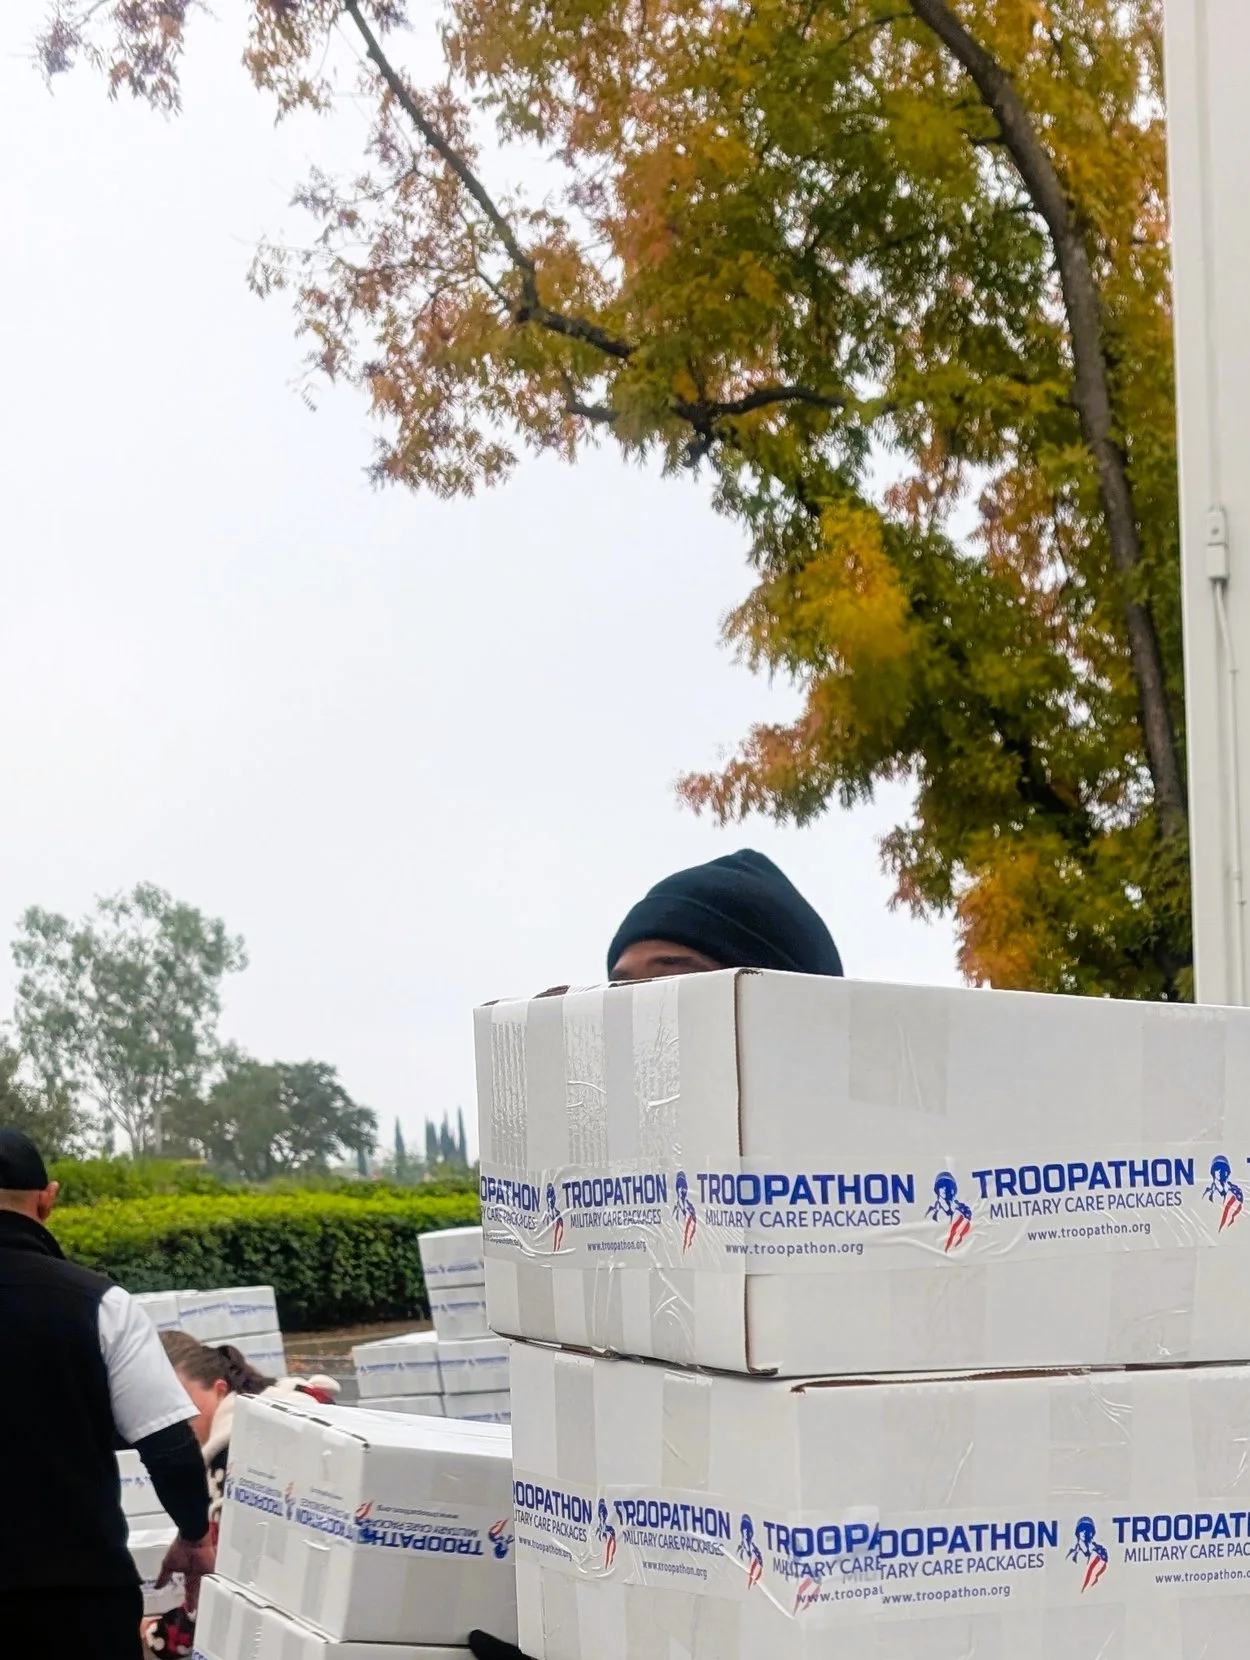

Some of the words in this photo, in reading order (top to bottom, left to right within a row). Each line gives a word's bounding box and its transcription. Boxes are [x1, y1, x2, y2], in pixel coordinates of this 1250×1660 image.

[696, 1173, 915, 1206] TROOPATHON
[972, 1158, 1194, 1199] TROOPATHON
[562, 1174, 668, 1209] TROOPATHON
[989, 1197, 1062, 1220] MILITARY
[1065, 1194, 1105, 1213] CARE
[1107, 1191, 1182, 1211] PACKAGES
[570, 1212, 601, 1229] MILITARY
[603, 1210, 622, 1227] CARE
[759, 1210, 808, 1228] CARE
[812, 1209, 901, 1227] PACKAGES
[1027, 1221, 1151, 1242] www.troopathon.org
[587, 1239, 647, 1253] www.troopathon.org
[725, 1241, 864, 1256] www.troopathon.org
[513, 1480, 593, 1525] OOPATHON
[533, 1514, 552, 1534] CARE
[552, 1519, 588, 1544] PACKAGES
[613, 1499, 731, 1540] TROOPATHON
[622, 1530, 658, 1549] MILITARY
[659, 1534, 680, 1551] CARE
[922, 1559, 964, 1577] CARE
[967, 1553, 1045, 1574] PACKAGES
[1124, 1544, 1188, 1563] MILITARY
[1190, 1543, 1225, 1560] CARE
